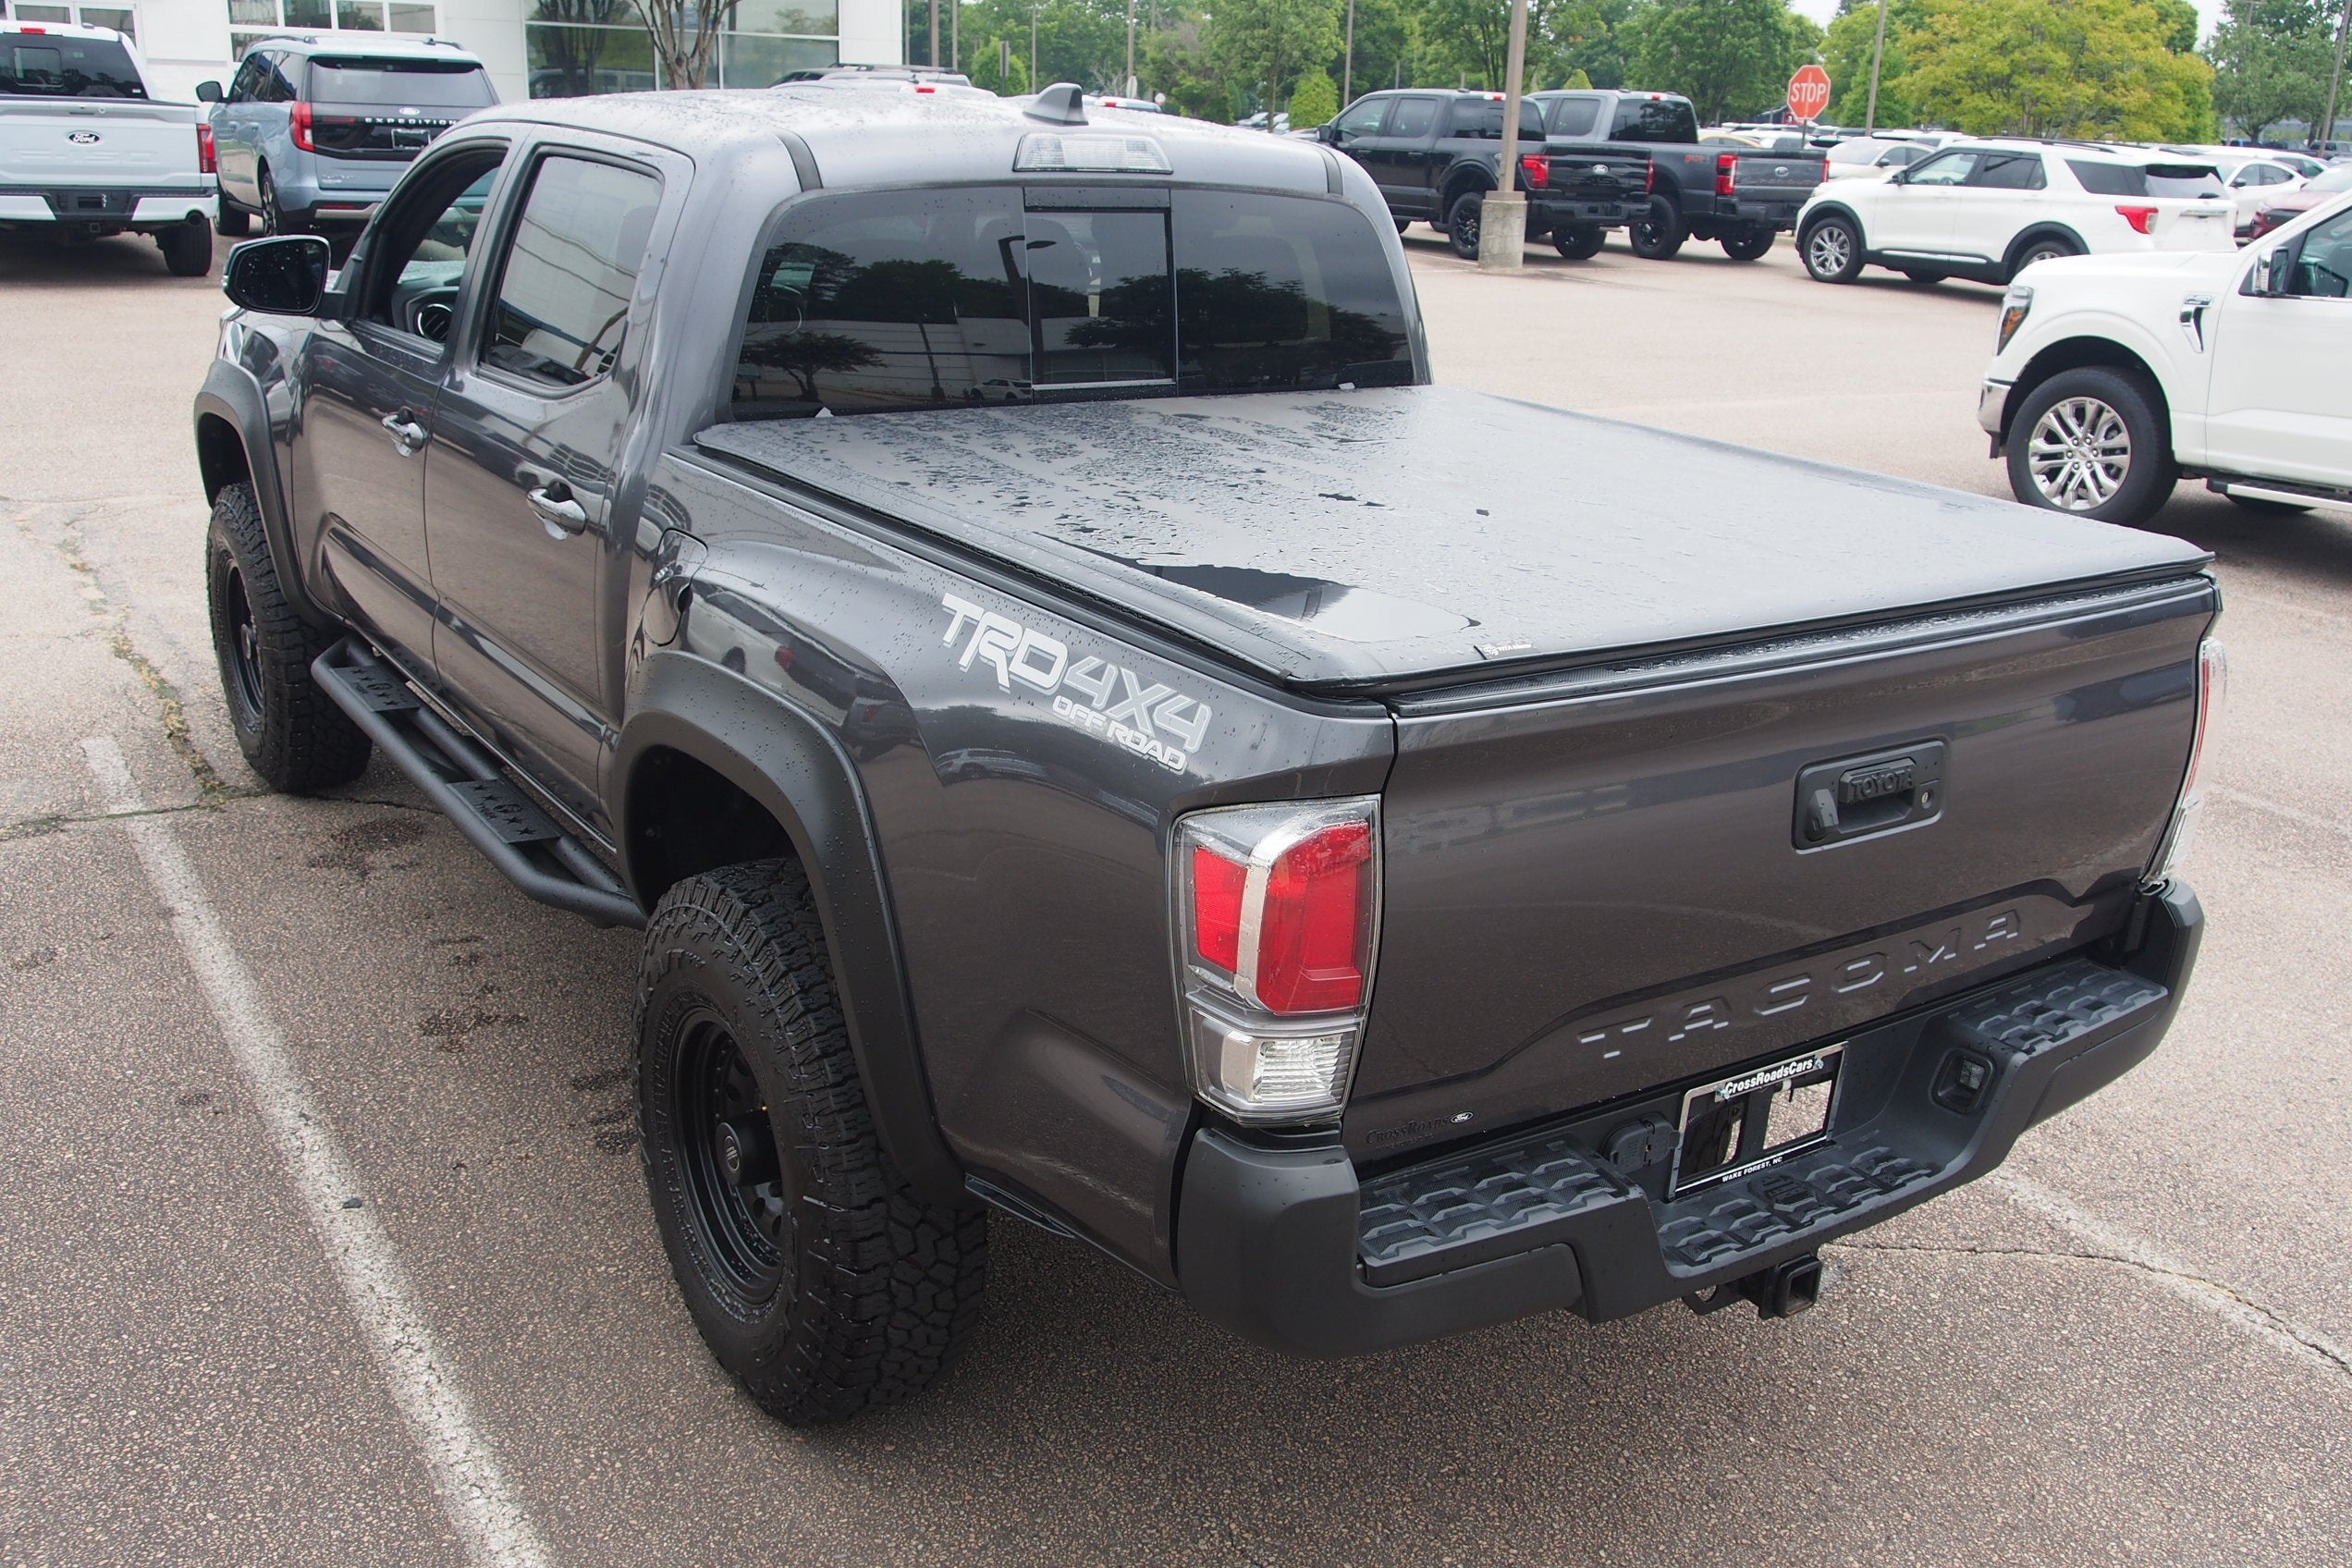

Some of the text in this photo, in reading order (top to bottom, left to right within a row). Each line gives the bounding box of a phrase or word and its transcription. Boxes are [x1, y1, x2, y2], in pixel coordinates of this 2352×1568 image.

[1791, 83, 1826, 102] STOP
[71, 132, 97, 143] Ford
[365, 116, 458, 126] EXPEDITION
[942, 592, 1068, 694] TRD
[1052, 695, 1189, 775] OFF ROAD
[1850, 768, 1914, 801] TOYOTA
[1577, 909, 2020, 1059] TACOMA
[1724, 1059, 1814, 1095] CrossRoadsCars
[1721, 1156, 1783, 1182] WAKE FOREST, NC
